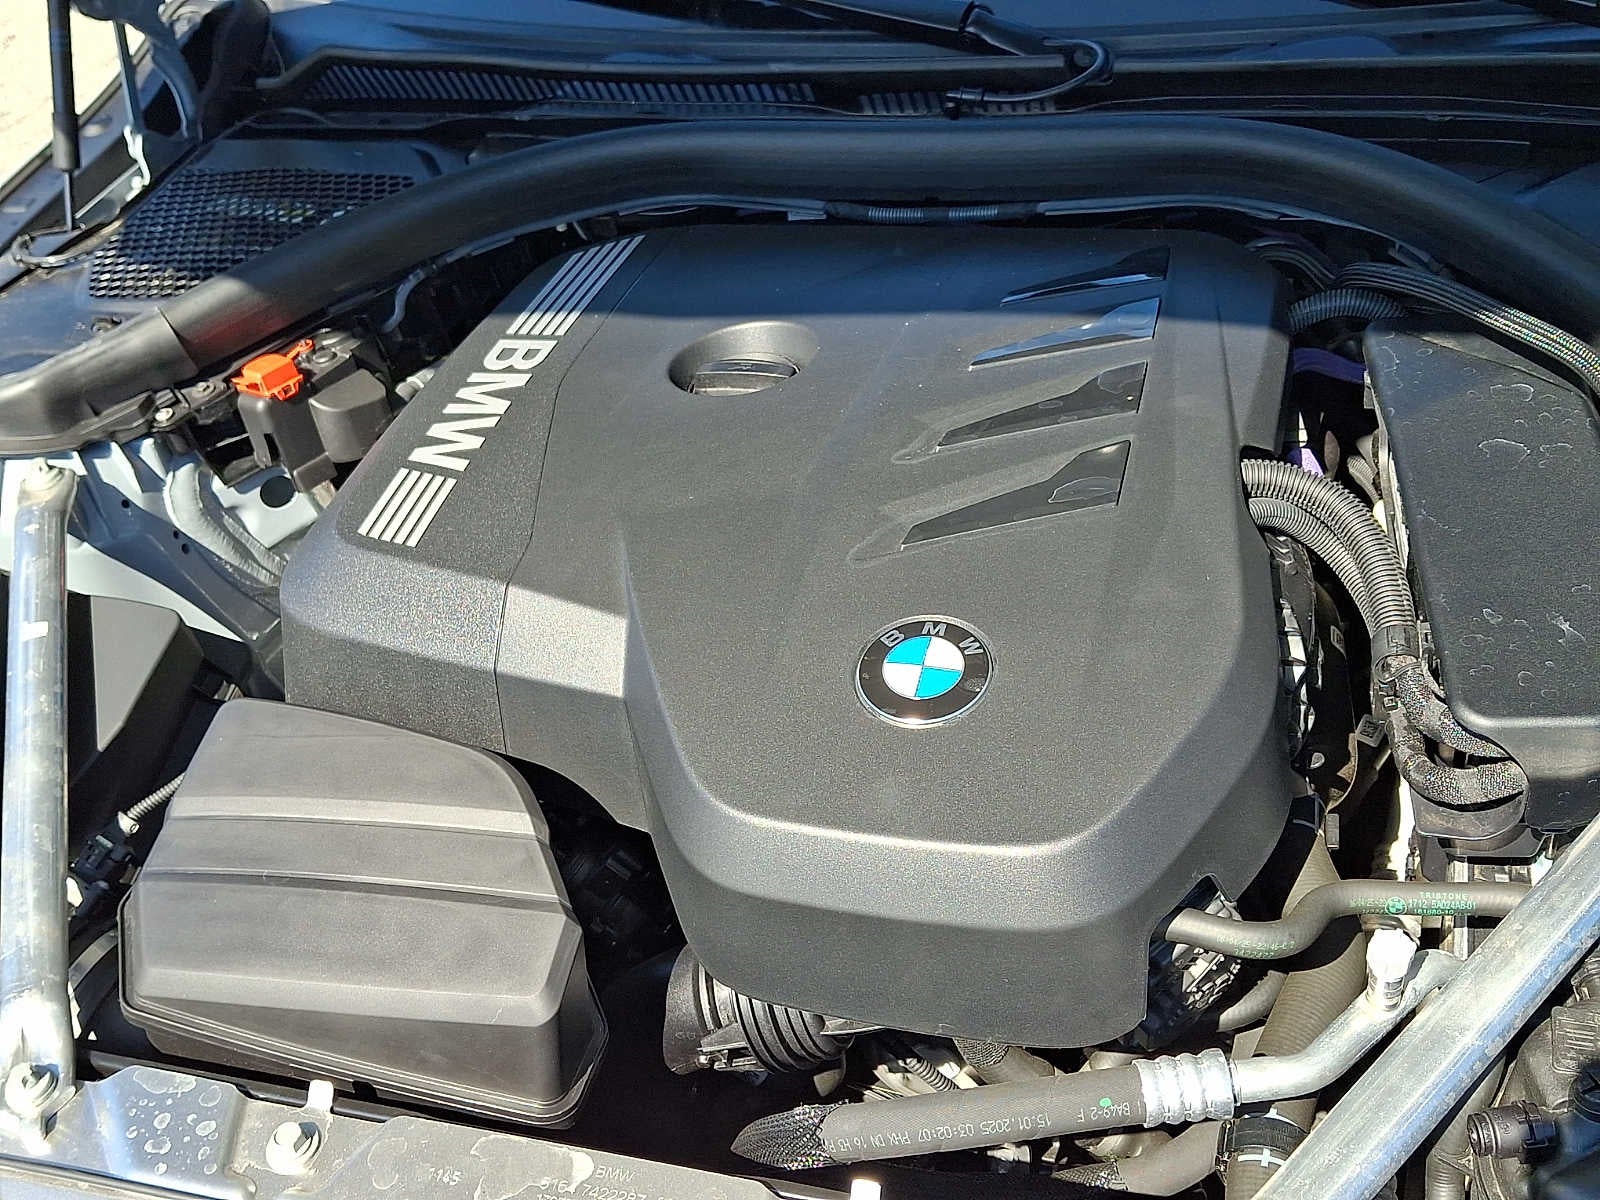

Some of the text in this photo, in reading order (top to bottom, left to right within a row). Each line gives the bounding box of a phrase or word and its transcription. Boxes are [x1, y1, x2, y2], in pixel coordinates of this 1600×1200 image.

[409, 339, 558, 472] BMW
[880, 621, 984, 655] BMW
[853, 1135, 867, 1150] 16
[869, 1134, 885, 1149] DN
[887, 1130, 911, 1146] PHX
[918, 1124, 974, 1144] 03:02:07
[595, 1165, 635, 1182] BMW
